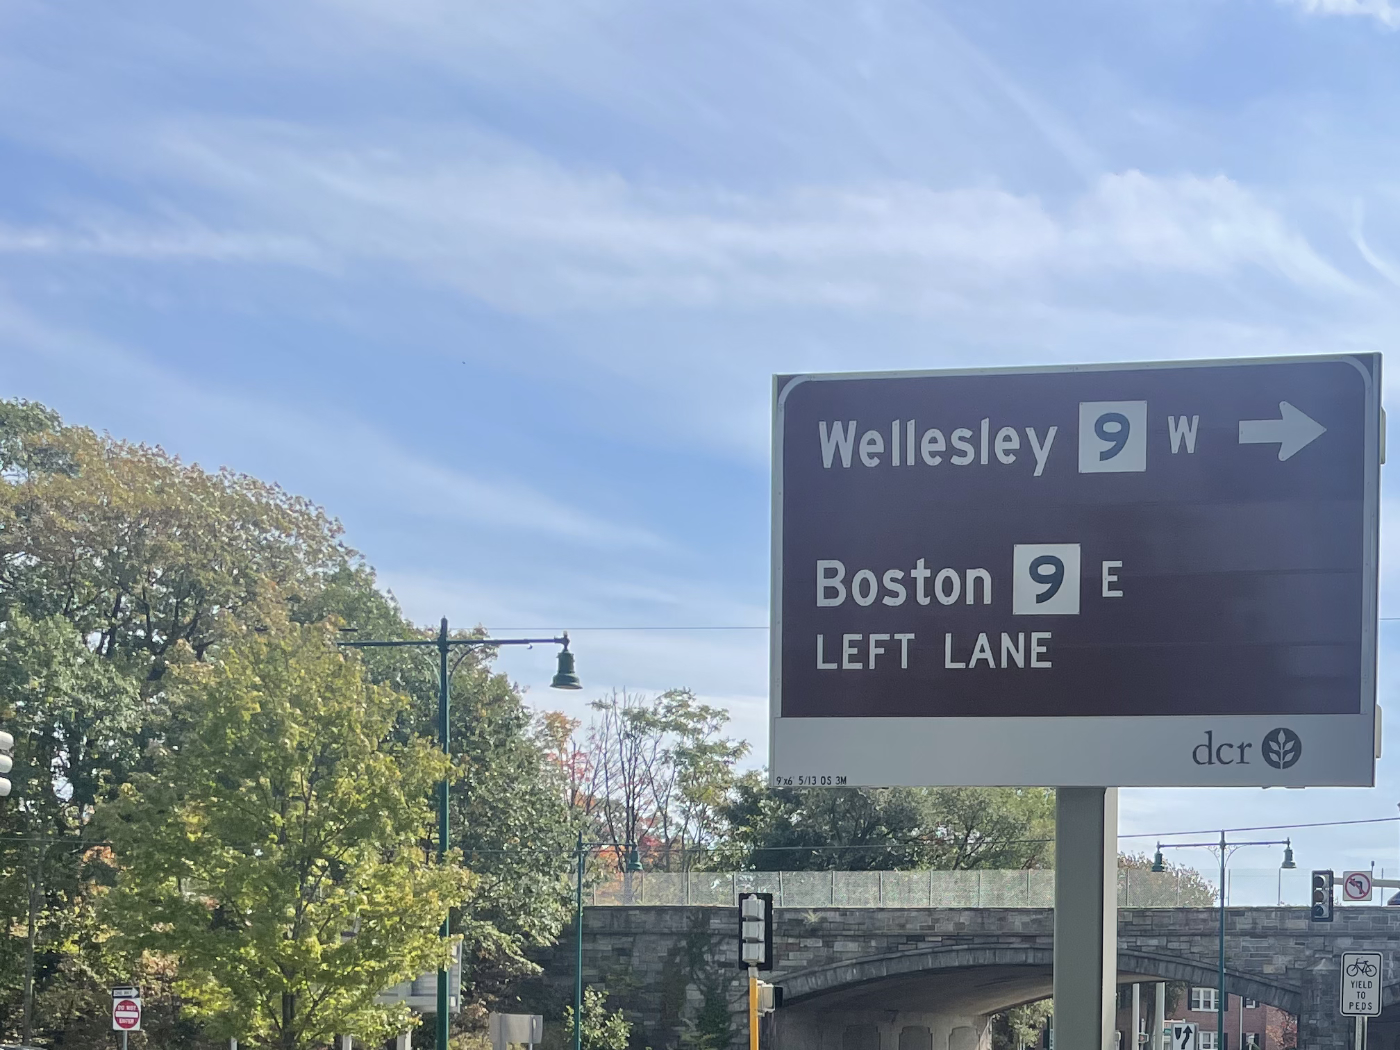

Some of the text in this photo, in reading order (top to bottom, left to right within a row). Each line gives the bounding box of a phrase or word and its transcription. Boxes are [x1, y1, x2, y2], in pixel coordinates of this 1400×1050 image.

[819, 412, 1199, 477] Wellesley 9 W
[817, 555, 1123, 607] Boston 9 E
[817, 632, 1052, 669] LEFT LANE
[1192, 730, 1252, 765] dcr
[798, 776, 817, 785] 5/13
[835, 776, 847, 785] 3M
[1351, 981, 1372, 989] YIELD
[1357, 991, 1366, 999] TO
[1349, 1002, 1373, 1010] PEDS
